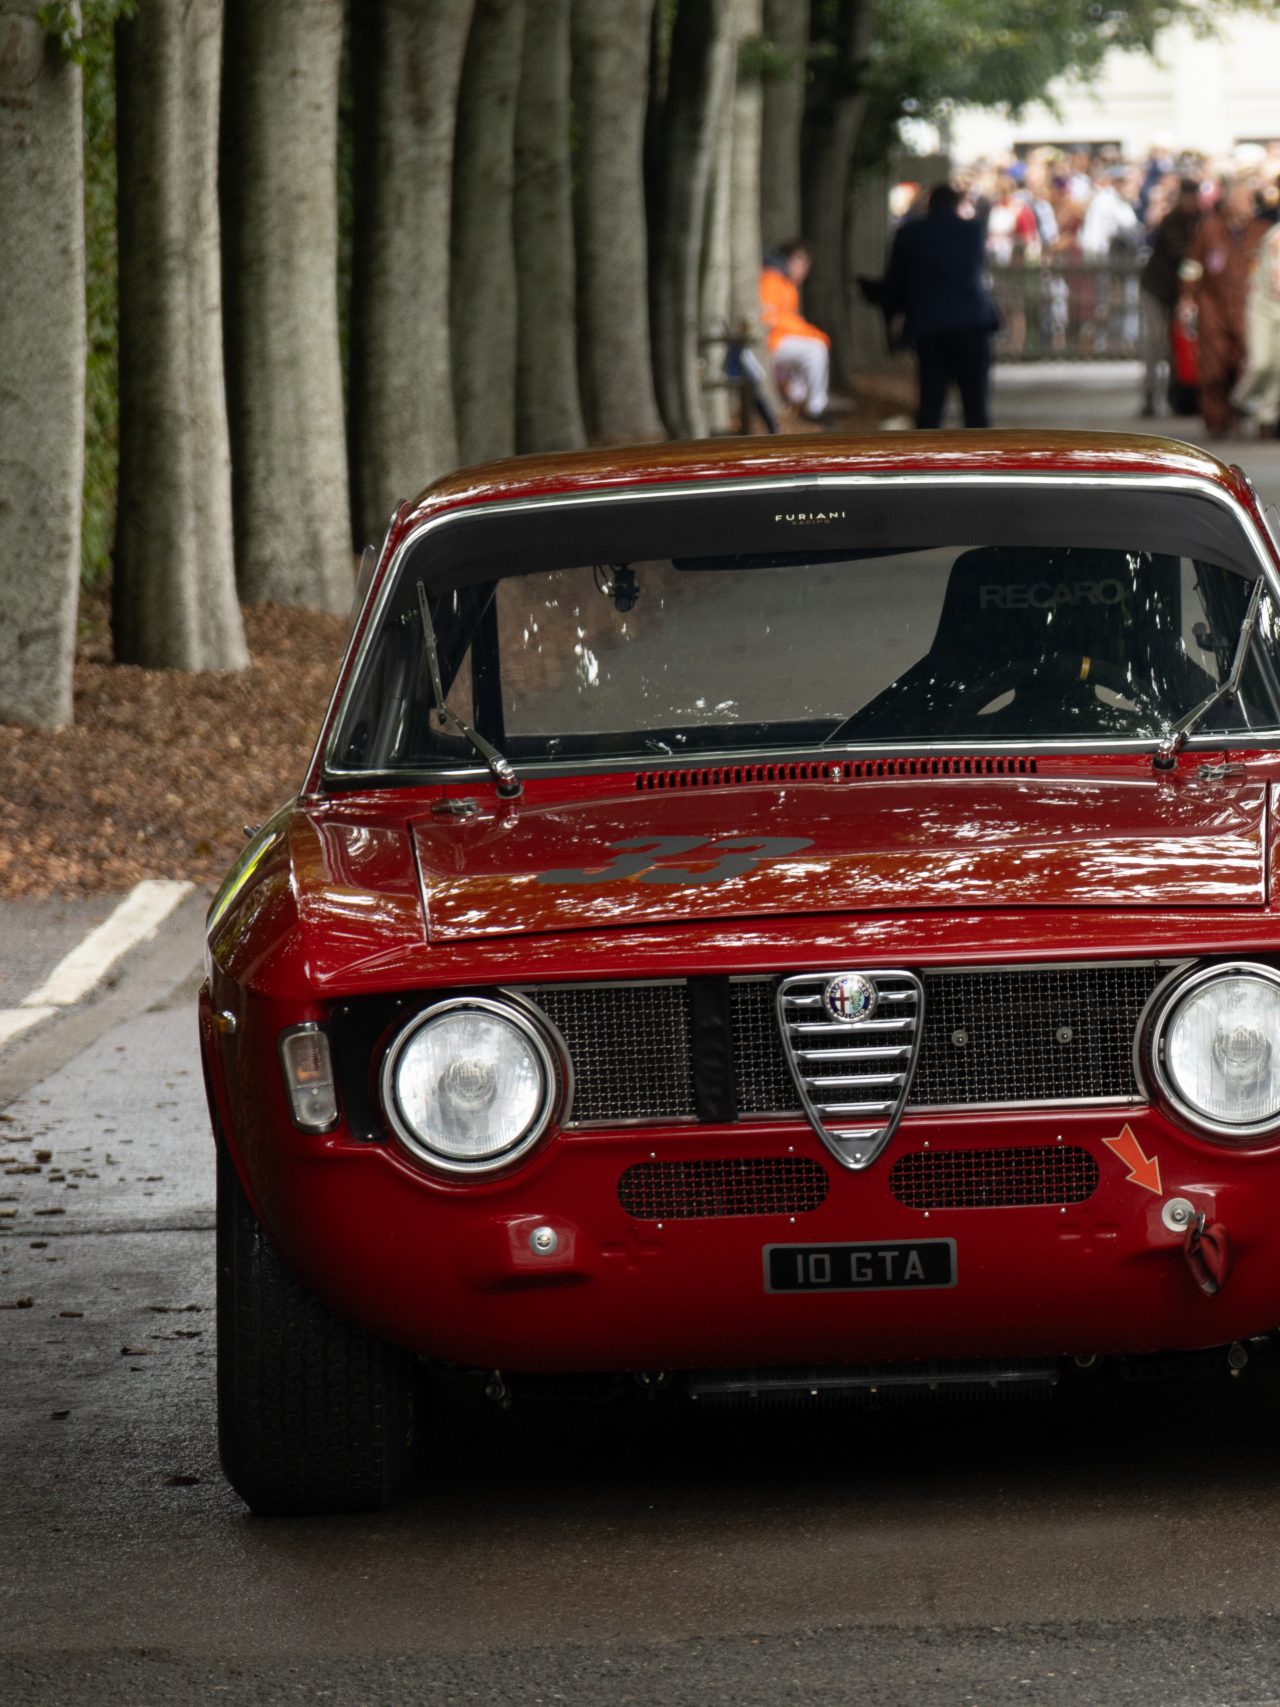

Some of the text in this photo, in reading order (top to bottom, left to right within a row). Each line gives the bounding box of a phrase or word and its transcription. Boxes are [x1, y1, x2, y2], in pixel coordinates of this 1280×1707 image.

[775, 511, 846, 522] FURIANI
[979, 579, 1125, 609] RECARO
[536, 835, 816, 885] 33
[797, 1250, 926, 1284] 10 GTA
